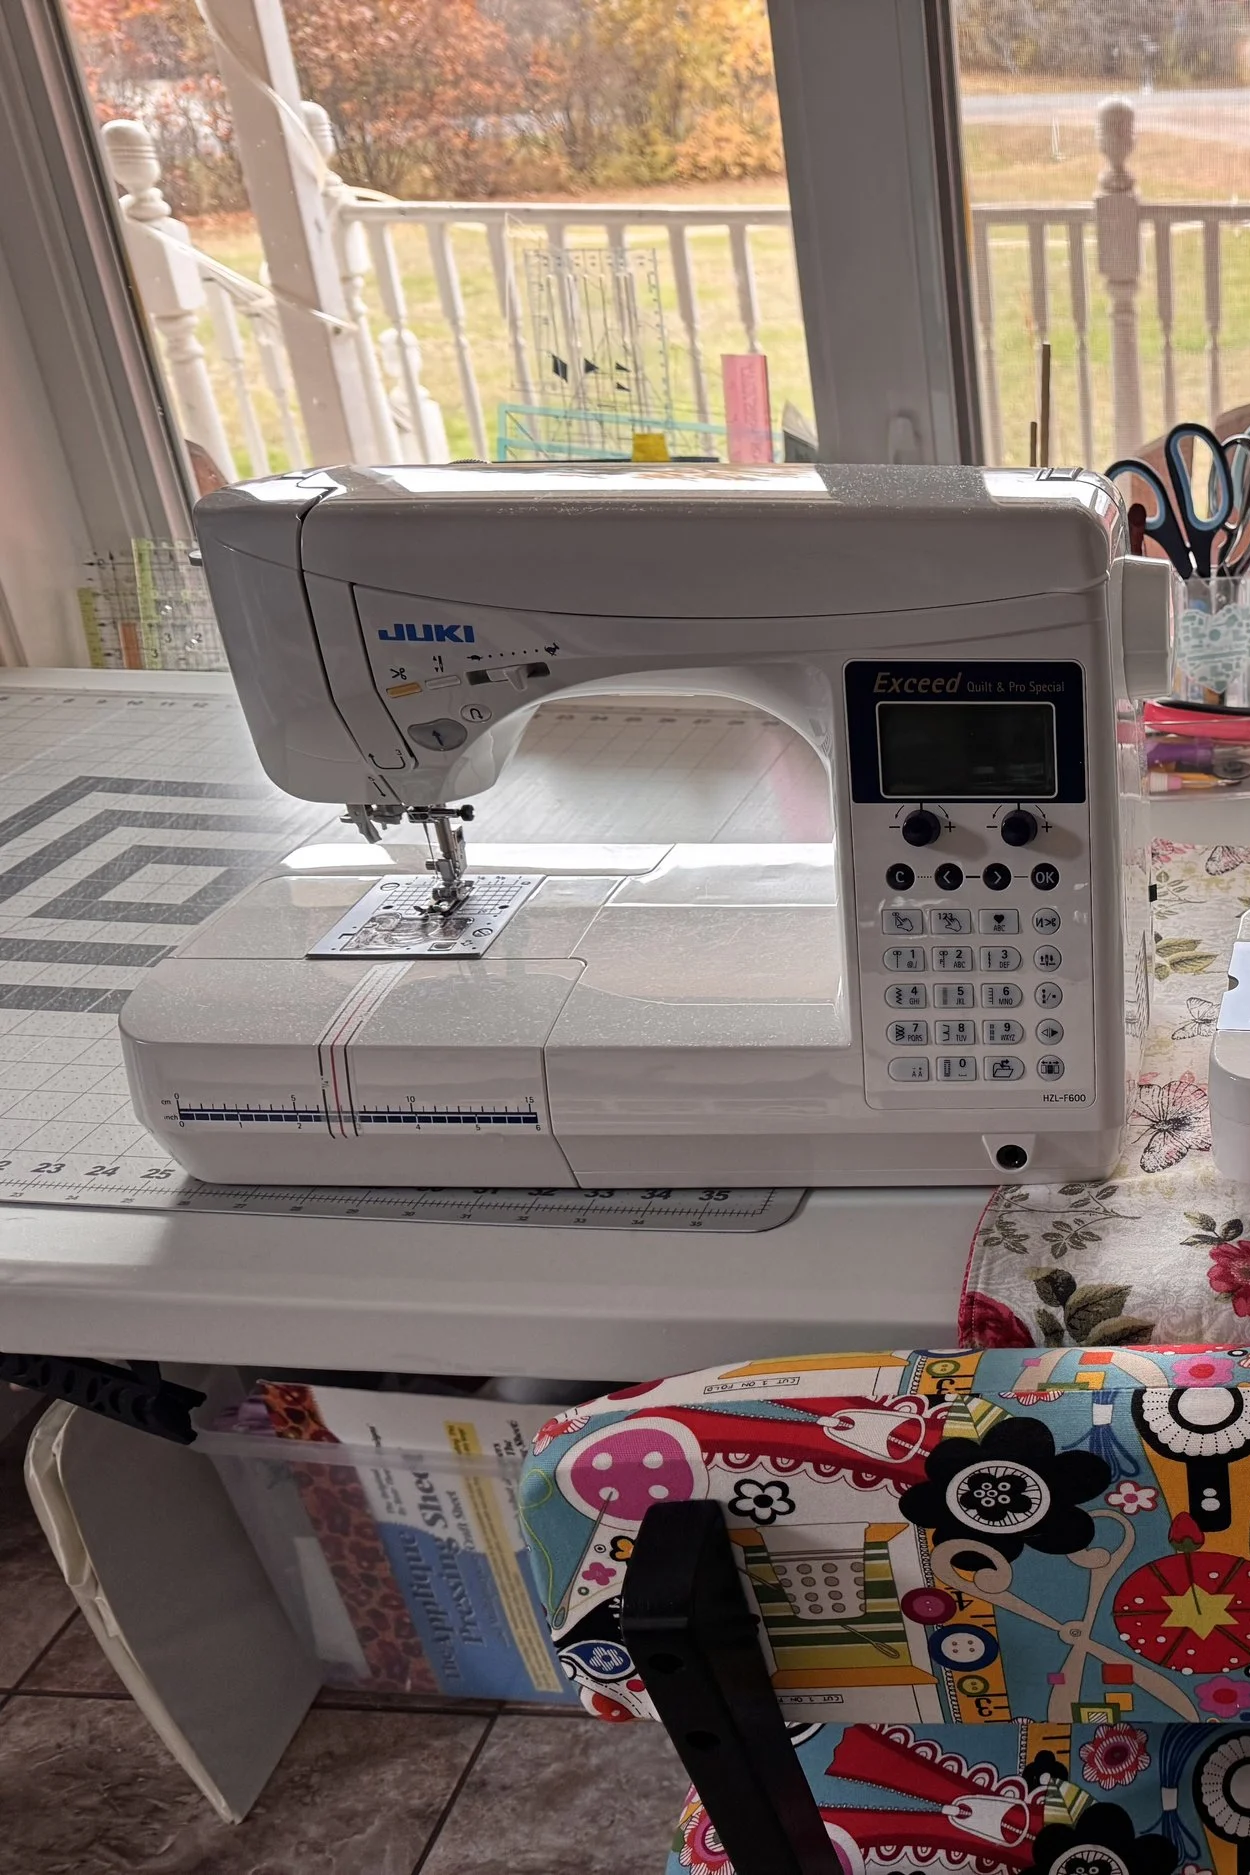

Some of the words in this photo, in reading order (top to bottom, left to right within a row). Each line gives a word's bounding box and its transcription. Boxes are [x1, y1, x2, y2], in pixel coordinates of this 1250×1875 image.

[378, 624, 475, 643] JUKI
[873, 672, 962, 694] Exceed
[967, 681, 993, 693] Quilt
[997, 681, 1005, 693] &
[1009, 681, 1026, 693] Pro
[1029, 681, 1065, 695] Special
[895, 871, 905, 883] C
[1035, 871, 1055, 884] OK
[910, 950, 915, 958] 1
[956, 950, 963, 959] 2
[1001, 950, 1008, 959] 3
[911, 986, 918, 995] 4
[957, 986, 964, 996] 5
[1002, 986, 1010, 996] 6
[912, 1023, 919, 1032] 7
[958, 1023, 965, 1032] 8
[1004, 1023, 1011, 1032] 9
[956, 1034, 967, 1042] TUV
[959, 1058, 966, 1068] 0
[291, 1094, 296, 1102] 5
[406, 1095, 416, 1103] 10
[525, 1096, 534, 1104] 15
[1043, 1094, 1086, 1102] HZL-F600
[30, 1163, 66, 1174] 23
[84, 1165, 120, 1177] 24
[140, 1168, 175, 1180] 25
[641, 1188, 673, 1200] 34
[698, 1188, 732, 1201] 35
[707, 1383, 733, 1392] FOLD
[975, 1697, 992, 1717] 3
